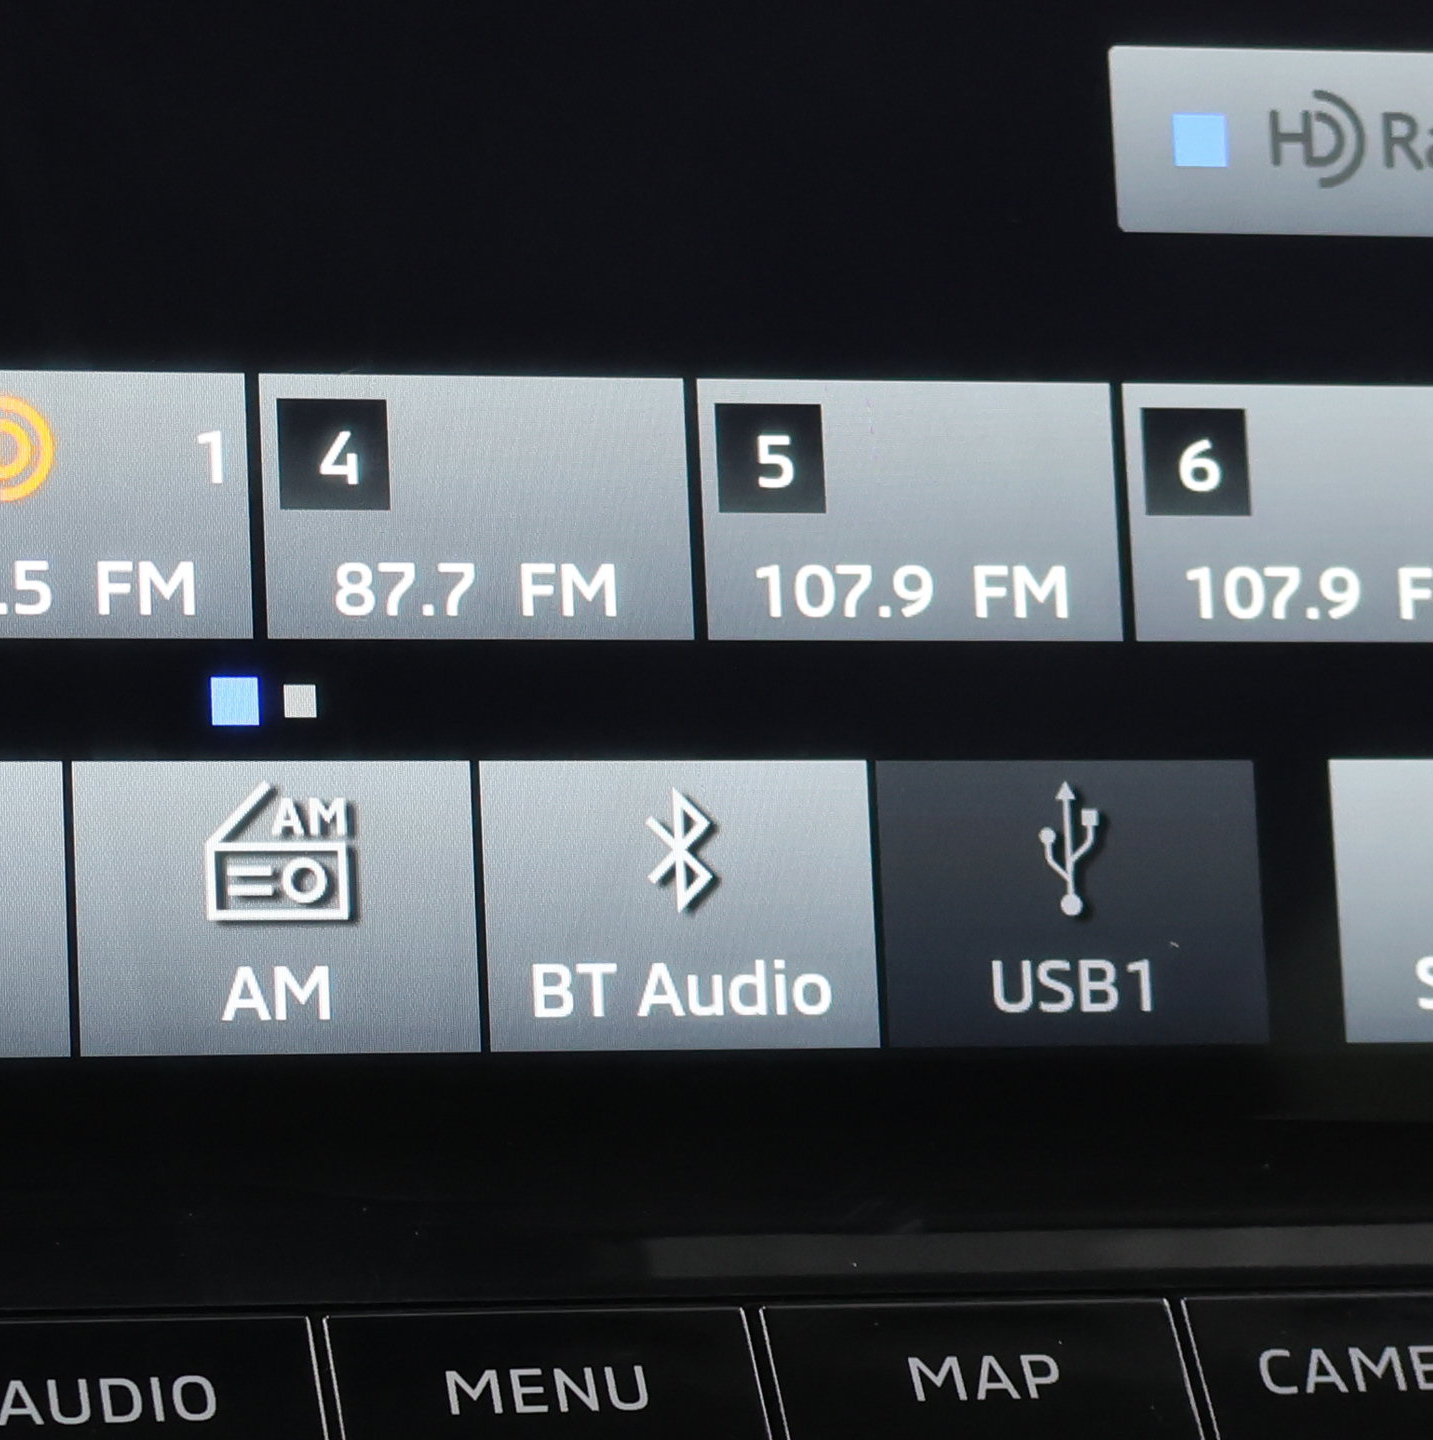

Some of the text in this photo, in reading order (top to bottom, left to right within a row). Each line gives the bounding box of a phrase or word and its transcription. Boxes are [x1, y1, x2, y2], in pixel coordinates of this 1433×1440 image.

[196, 431, 224, 484] 1
[319, 431, 360, 485] 4
[755, 434, 795, 489] 5
[1179, 440, 1221, 492] 6
[97, 560, 196, 616] FM
[334, 562, 618, 617] 87.7 FM
[755, 564, 1070, 619] 107.9 FM
[1186, 566, 1361, 620] 107.9
[271, 797, 347, 837] AM
[221, 966, 332, 1022] AM
[531, 959, 833, 1019] BT Audio
[991, 959, 1153, 1014] USB1
[445, 1365, 650, 1415] MENU
[909, 1353, 1061, 1403] MAP
